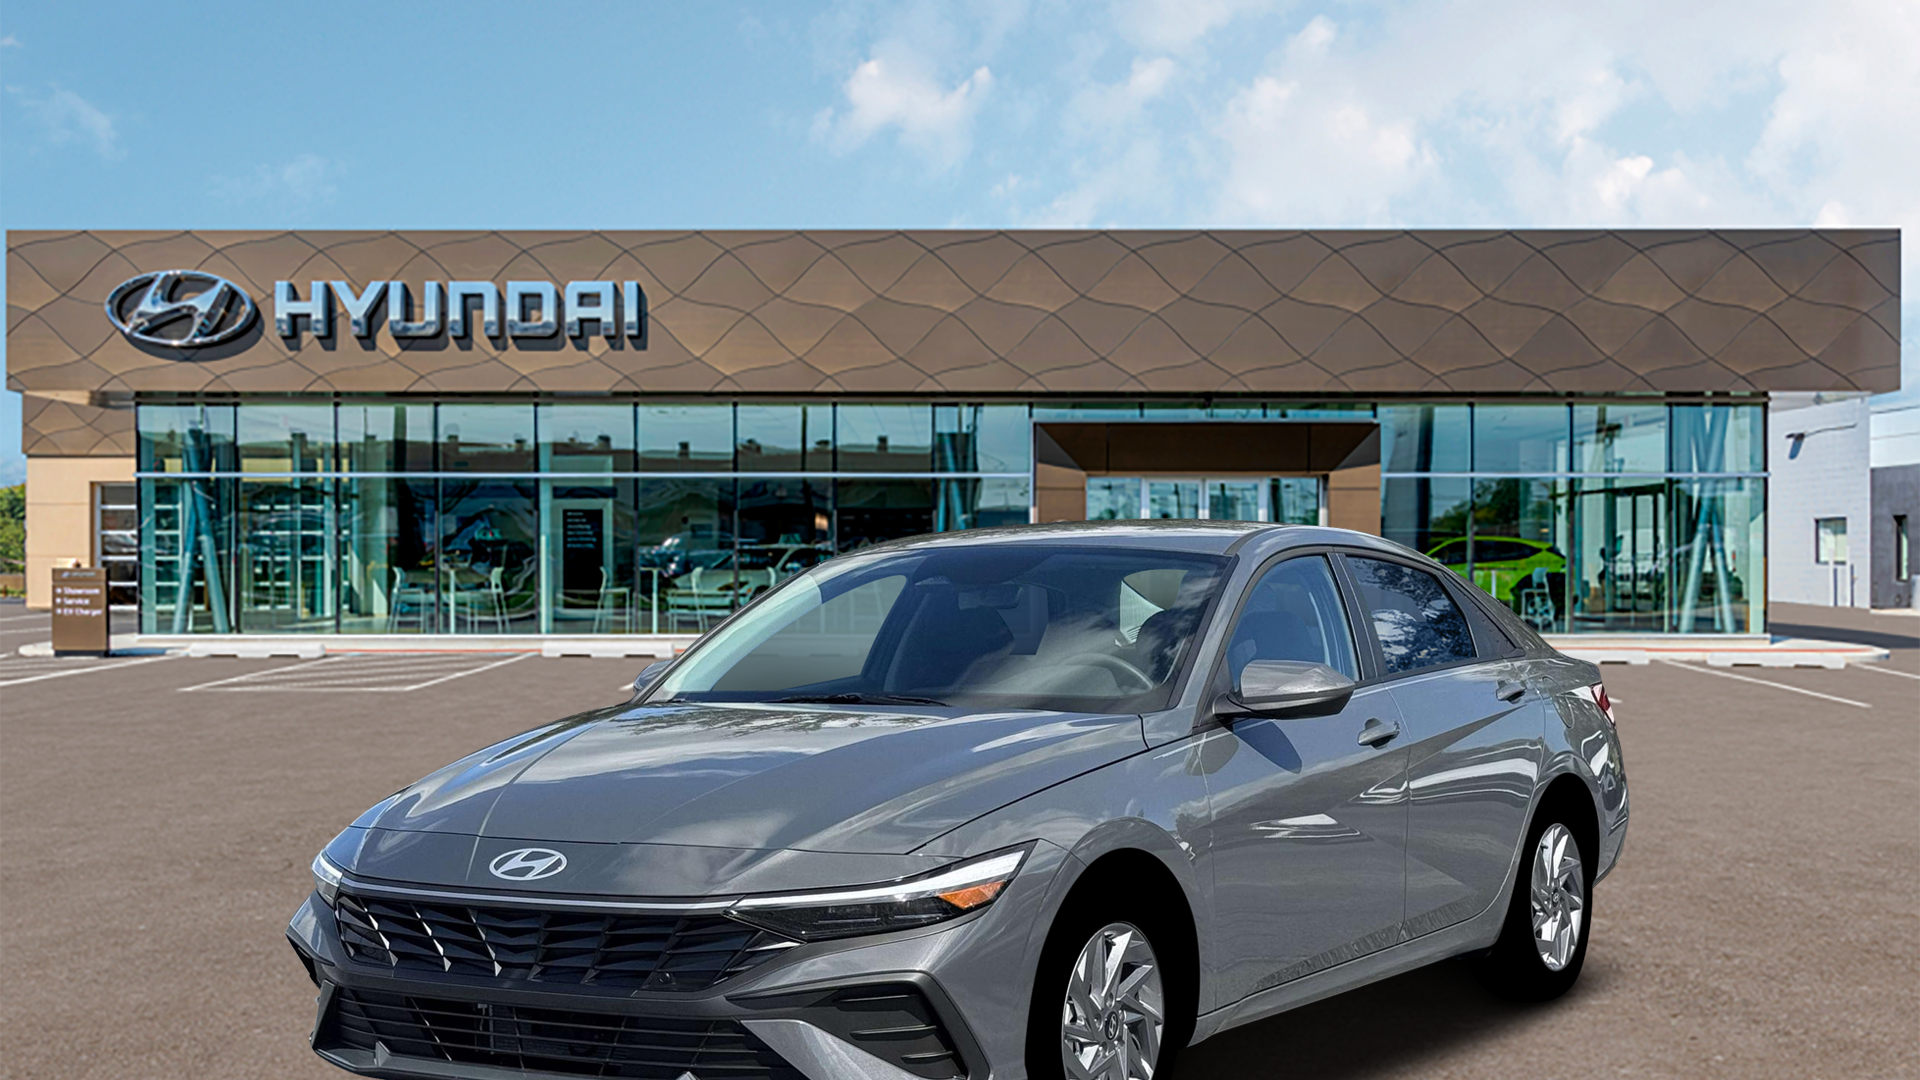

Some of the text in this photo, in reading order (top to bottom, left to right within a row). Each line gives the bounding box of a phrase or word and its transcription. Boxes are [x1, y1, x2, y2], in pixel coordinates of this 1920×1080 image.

[274, 280, 642, 342] HYUNDAI
[63, 587, 99, 595] Showroom
[63, 597, 90, 605] Service
